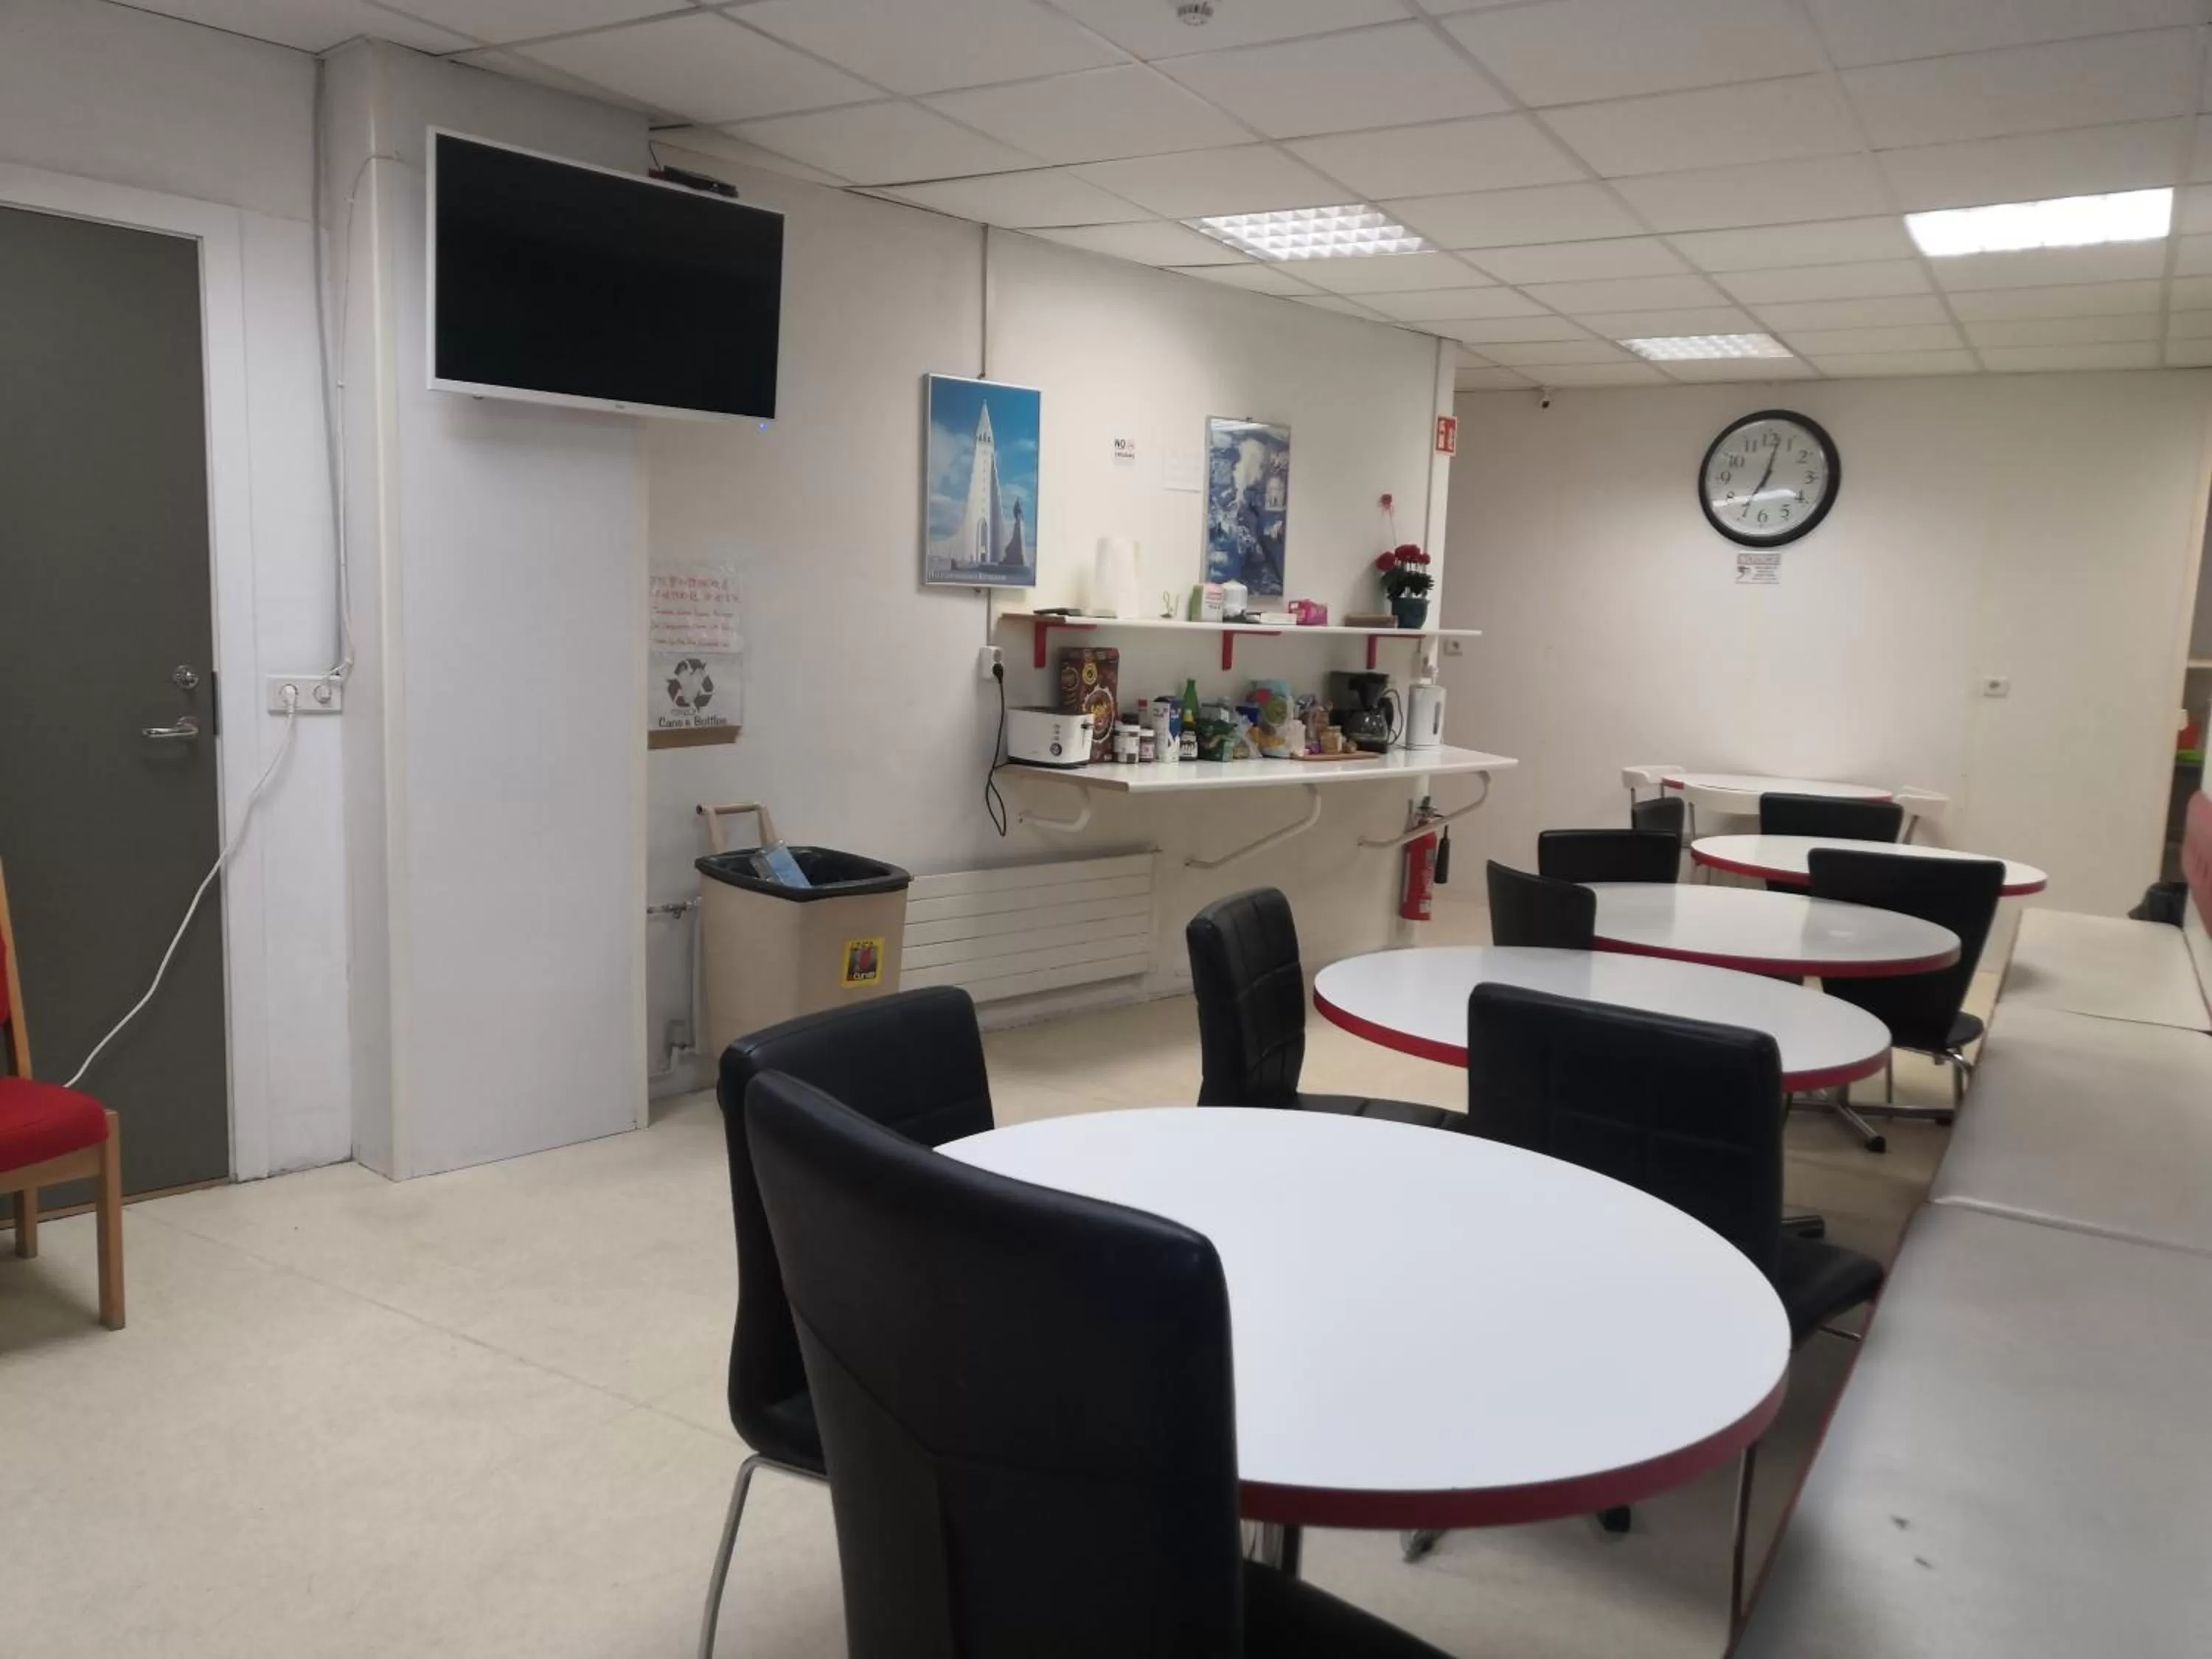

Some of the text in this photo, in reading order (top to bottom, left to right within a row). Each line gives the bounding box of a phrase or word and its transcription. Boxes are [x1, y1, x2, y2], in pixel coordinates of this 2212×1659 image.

[1114, 439, 1126, 449] NO
[1745, 438, 1757, 452] 11
[1762, 433, 1781, 447] 12
[1729, 455, 1745, 468] 10
[1796, 450, 1806, 464] 2
[1720, 471, 1731, 484] 9
[1805, 470, 1815, 484] 3
[1794, 490, 1805, 503] 4
[1757, 509, 1768, 523] 6
[1781, 504, 1790, 518] 5
